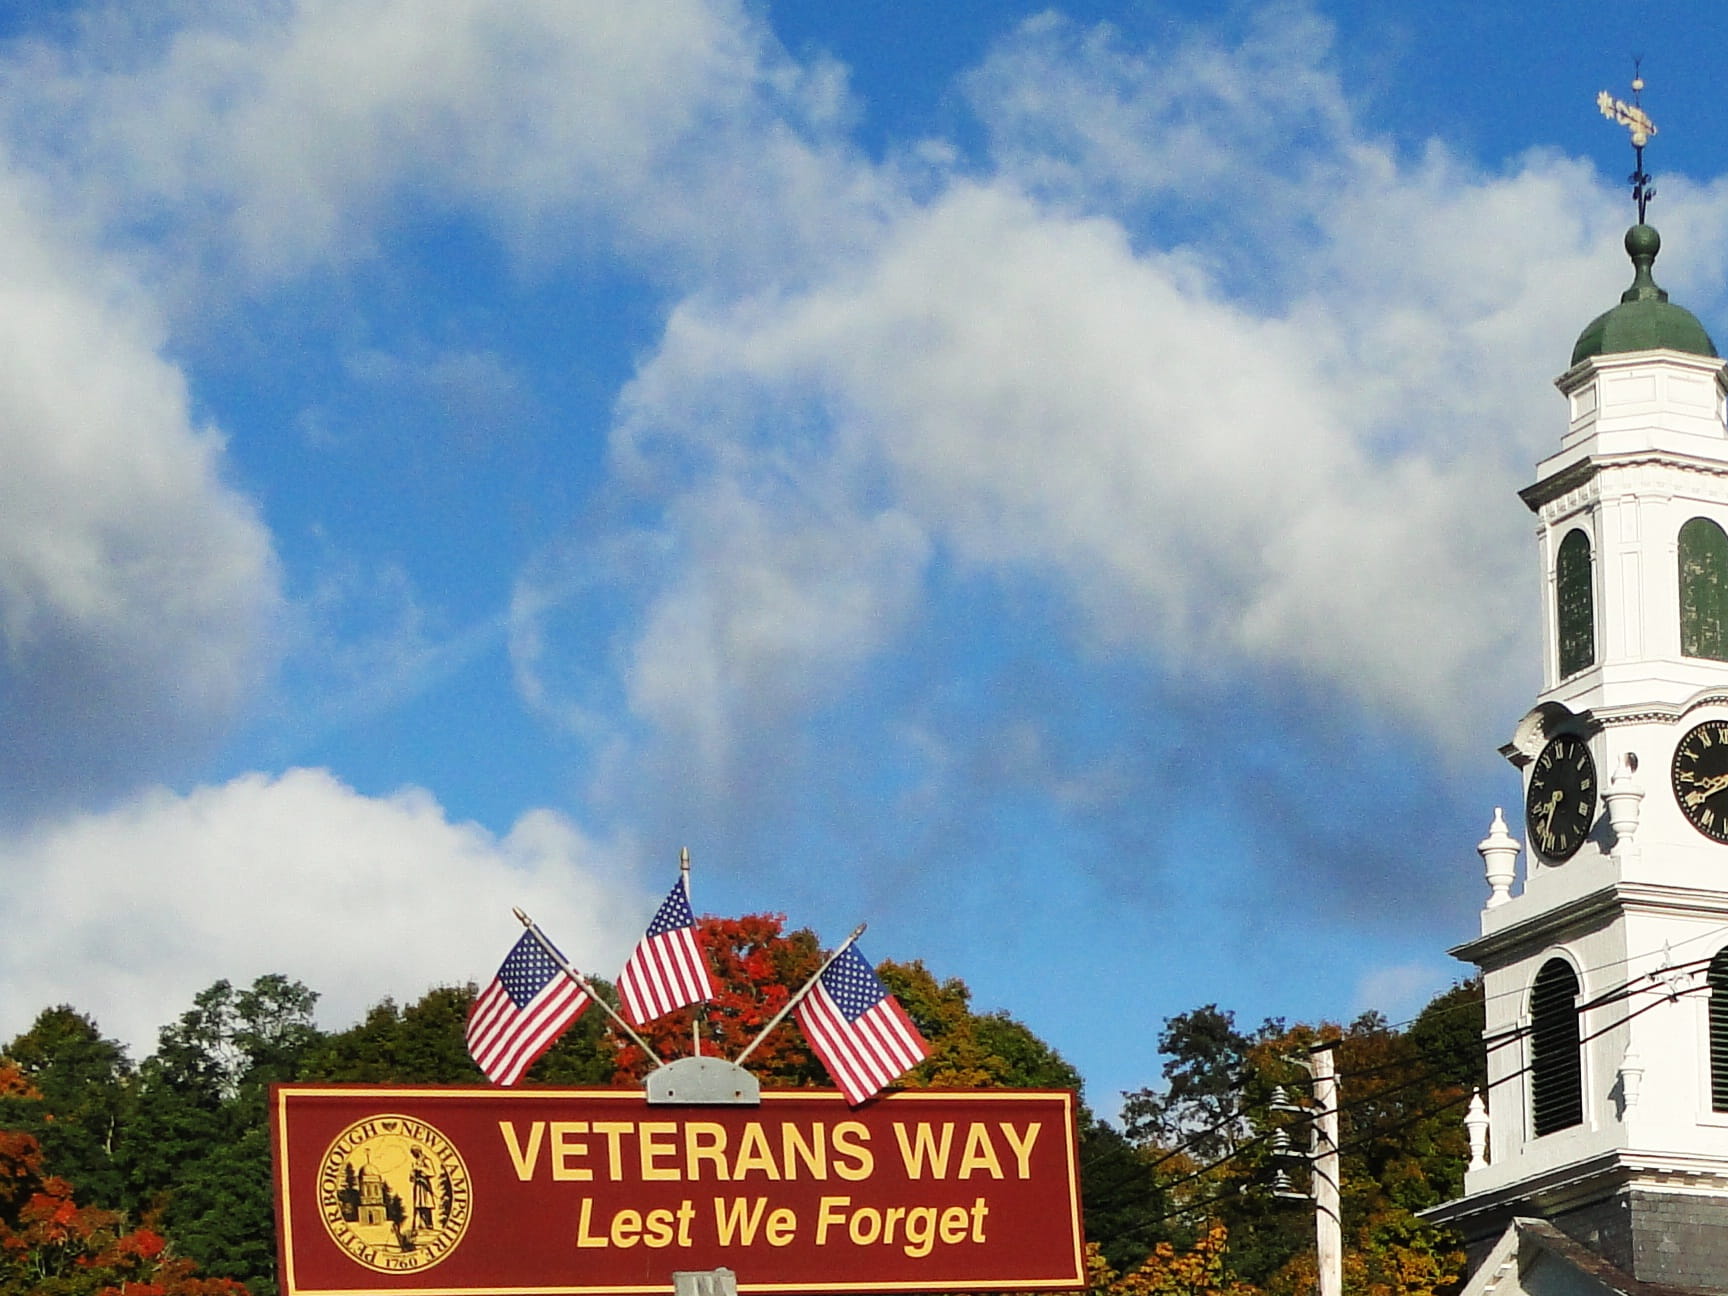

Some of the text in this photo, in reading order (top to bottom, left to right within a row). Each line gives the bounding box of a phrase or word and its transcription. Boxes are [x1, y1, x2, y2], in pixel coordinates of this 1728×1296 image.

[498, 1121, 1042, 1182] VETERANS WAY
[322, 1121, 378, 1265] PETERBOROUGH
[399, 1120, 469, 1264] NEW HAMPSHIRE
[577, 1196, 989, 1258] Lest We Forget
[385, 1256, 418, 1269] 1760
